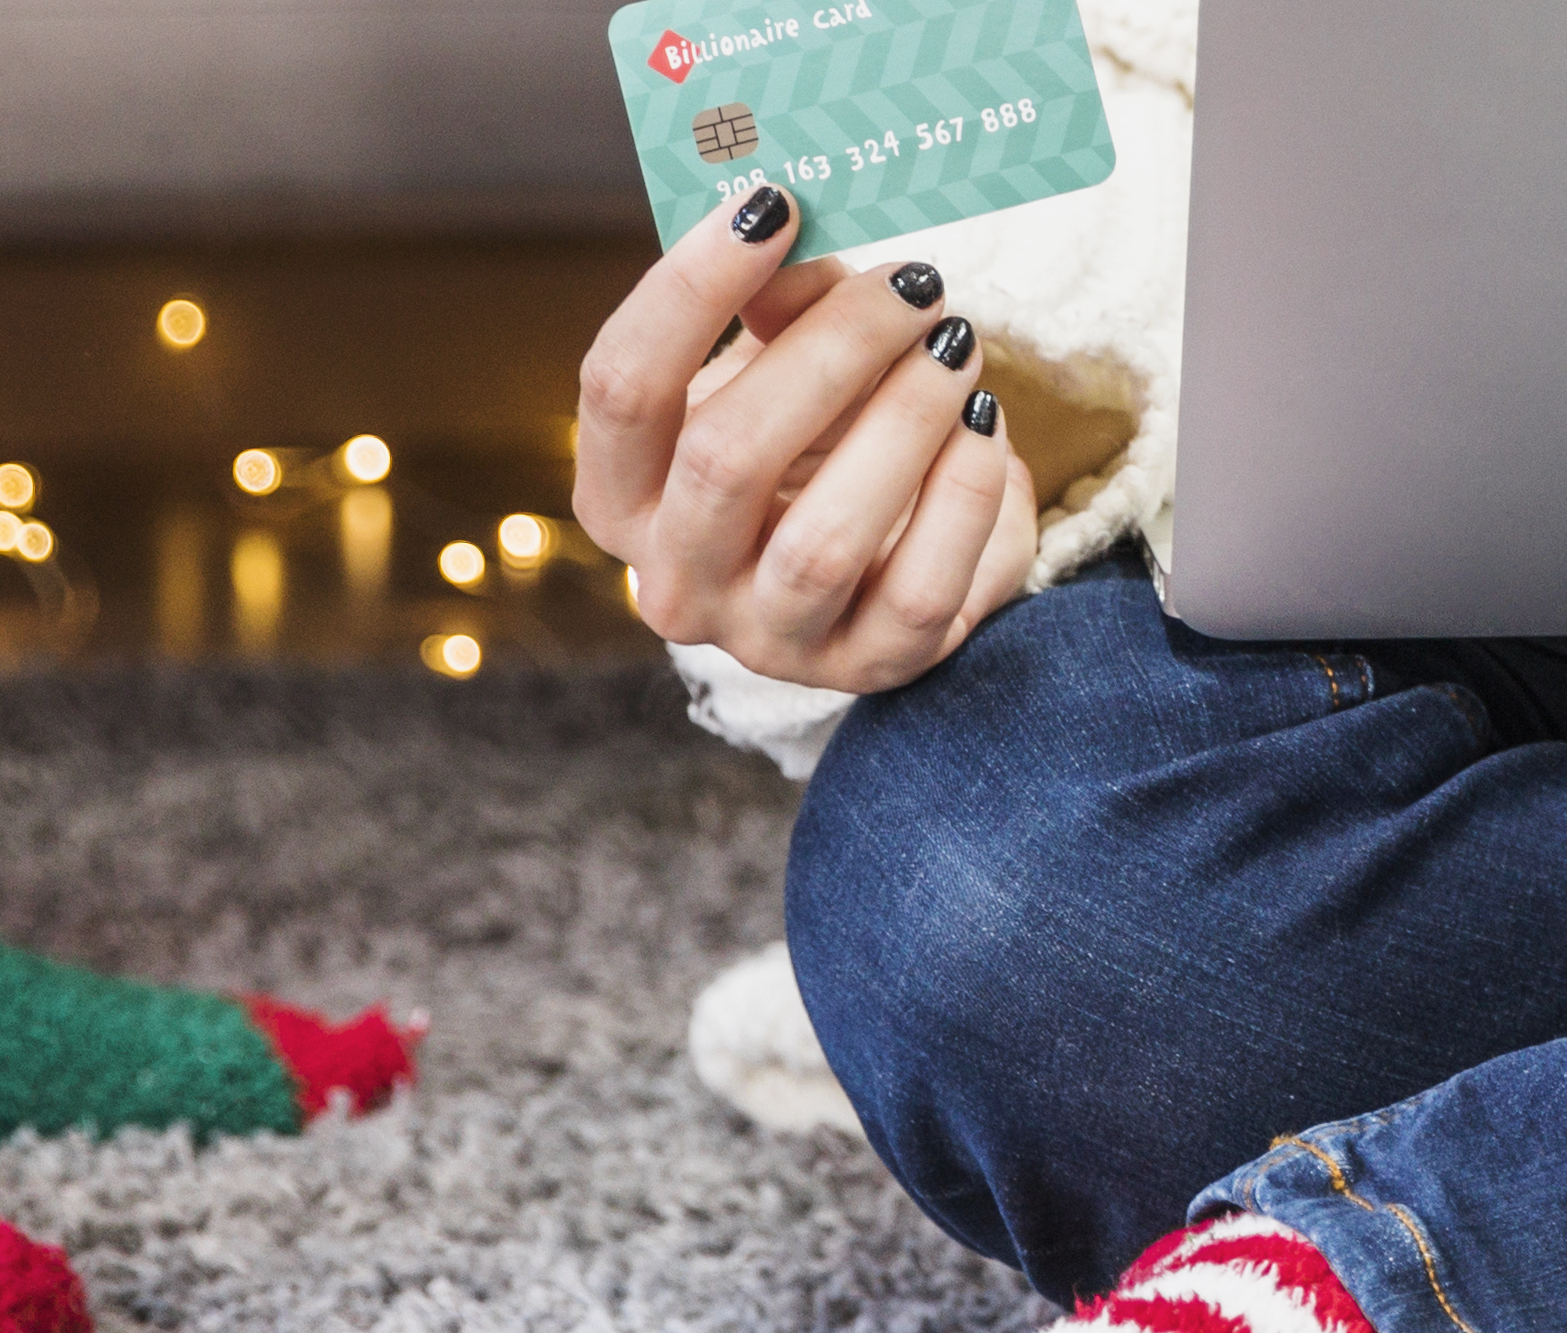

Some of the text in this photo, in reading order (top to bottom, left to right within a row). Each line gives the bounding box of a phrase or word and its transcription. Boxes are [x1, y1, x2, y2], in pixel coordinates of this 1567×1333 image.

[664, 18, 800, 70] Billionaire
[783, 155, 832, 185] 163
[845, 130, 900, 172] 324
[915, 116, 964, 151] 567
[980, 98, 1037, 133] 888
